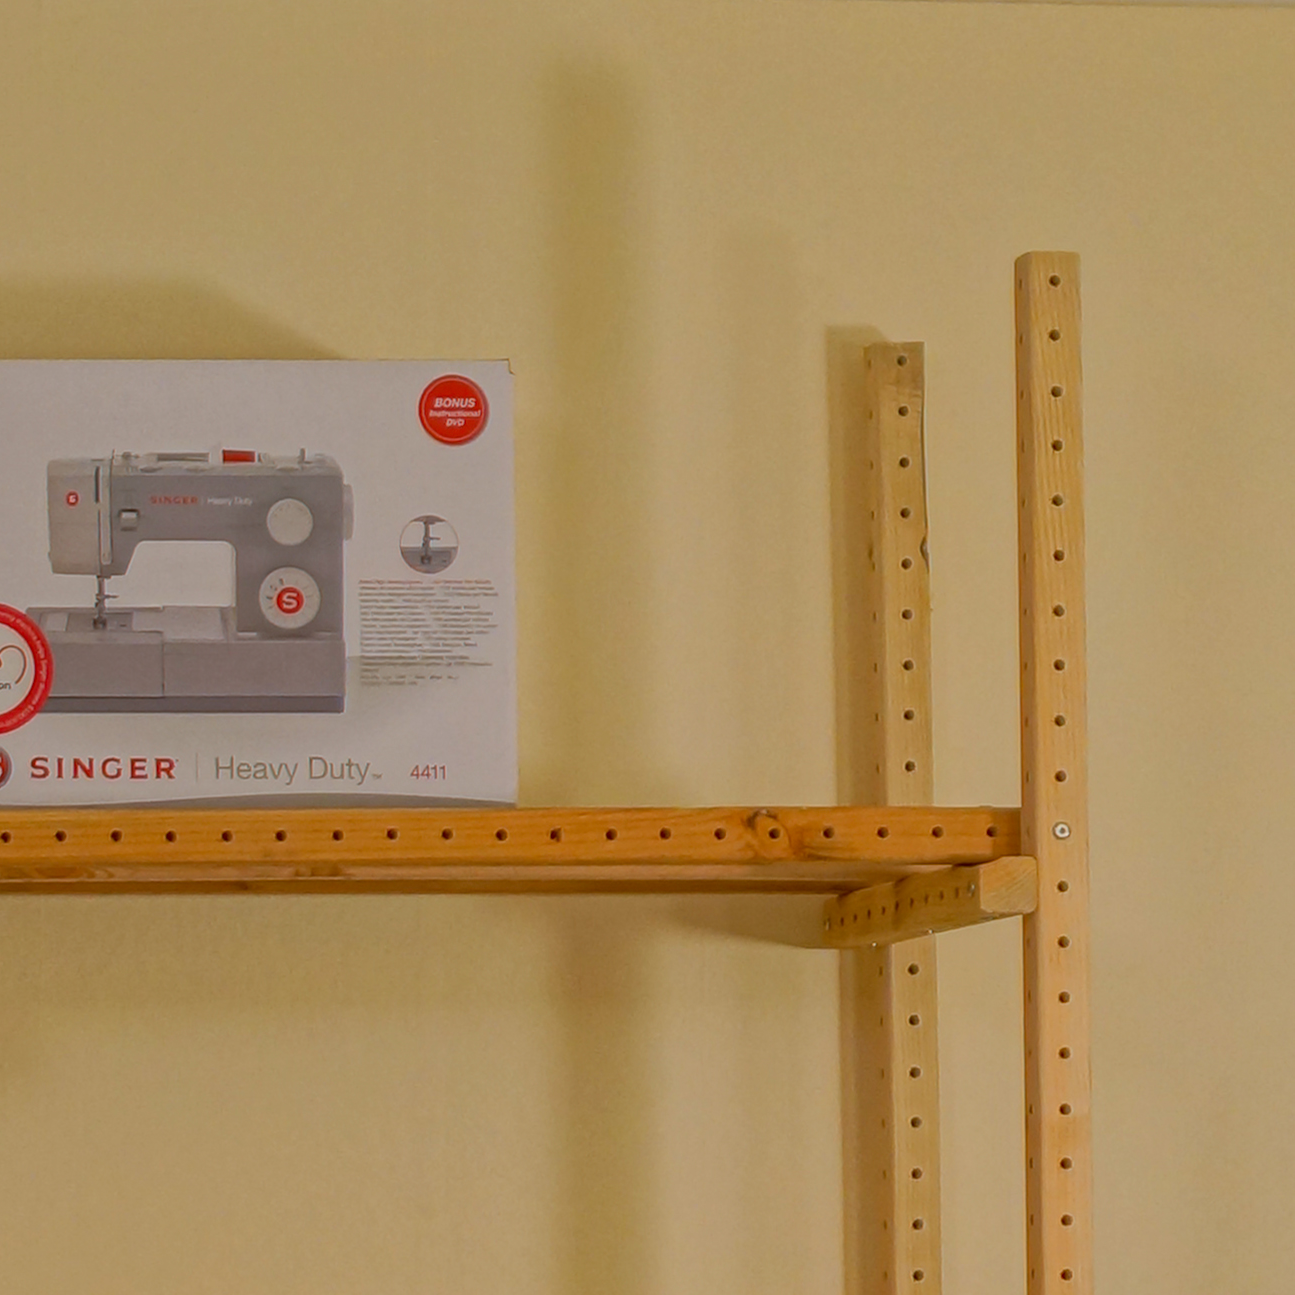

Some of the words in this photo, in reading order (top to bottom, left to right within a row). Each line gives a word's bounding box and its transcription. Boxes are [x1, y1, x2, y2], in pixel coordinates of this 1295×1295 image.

[433, 397, 477, 408] BONUS
[428, 408, 482, 418] Instructional
[445, 418, 466, 427] DVD
[150, 495, 198, 505] SINGER
[29, 756, 178, 780] SINGER
[214, 755, 299, 786] Heavy
[409, 764, 448, 780] 4411
